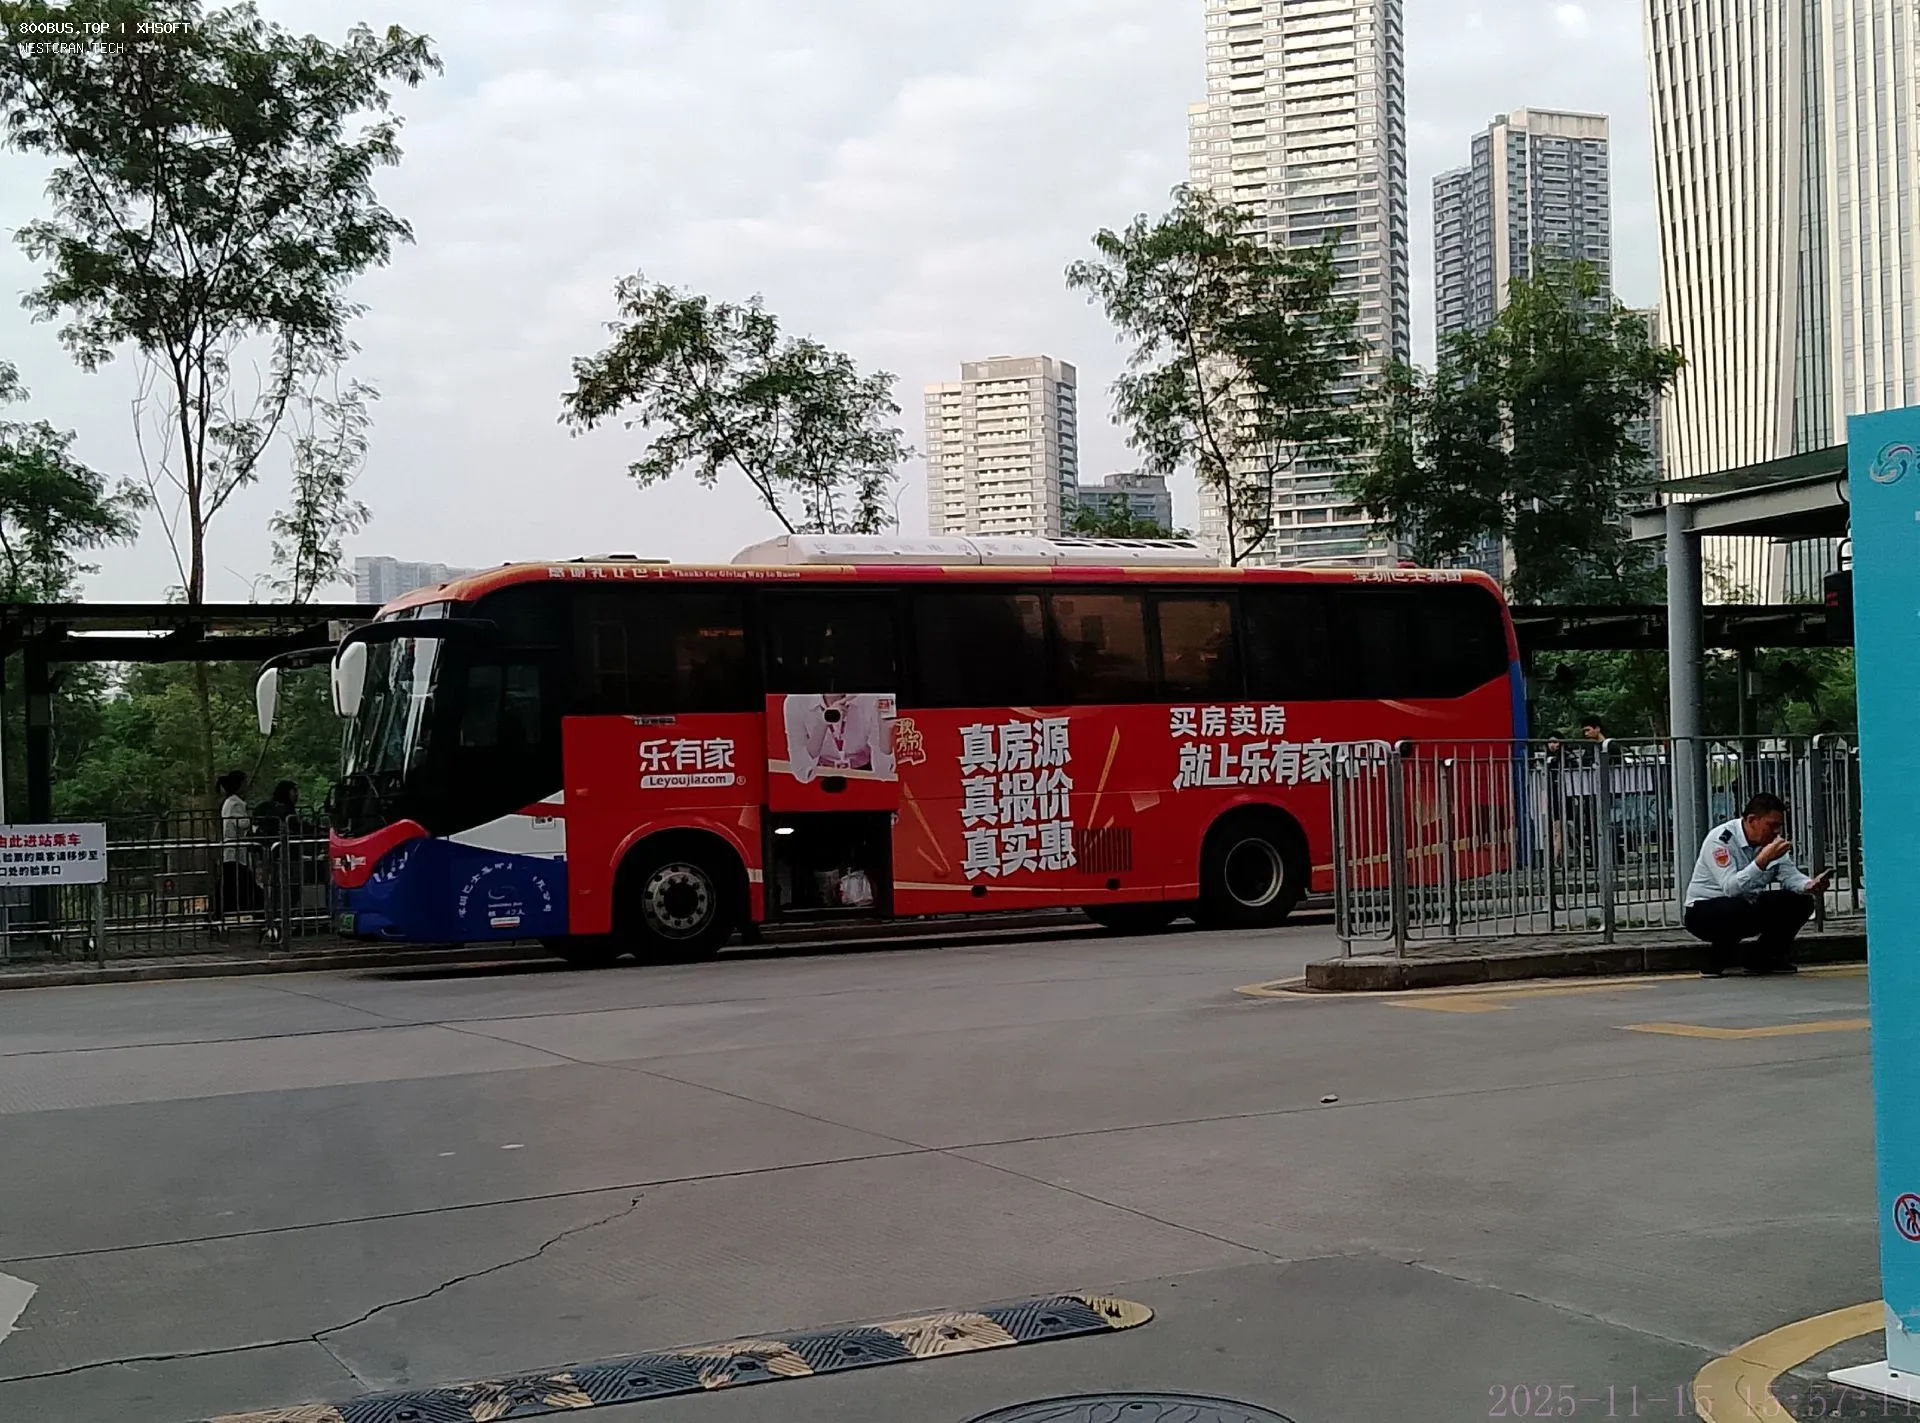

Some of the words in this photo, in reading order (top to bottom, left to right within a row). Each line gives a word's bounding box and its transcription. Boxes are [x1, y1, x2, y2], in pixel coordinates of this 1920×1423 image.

[672, 569, 704, 578] Thanks
[705, 570, 717, 578] for
[719, 570, 746, 579] Giving
[747, 570, 764, 579] Way
[765, 570, 775, 578] to
[1169, 704, 1287, 738] 买房卖房
[639, 738, 735, 772] 乐有家
[956, 716, 1072, 776] 真房源
[649, 774, 727, 787] Leyoujia.com
[957, 767, 1074, 828] 真报价
[0, 850, 99, 863] 验票的乘客请移步至
[960, 819, 1077, 881] 真实惠
